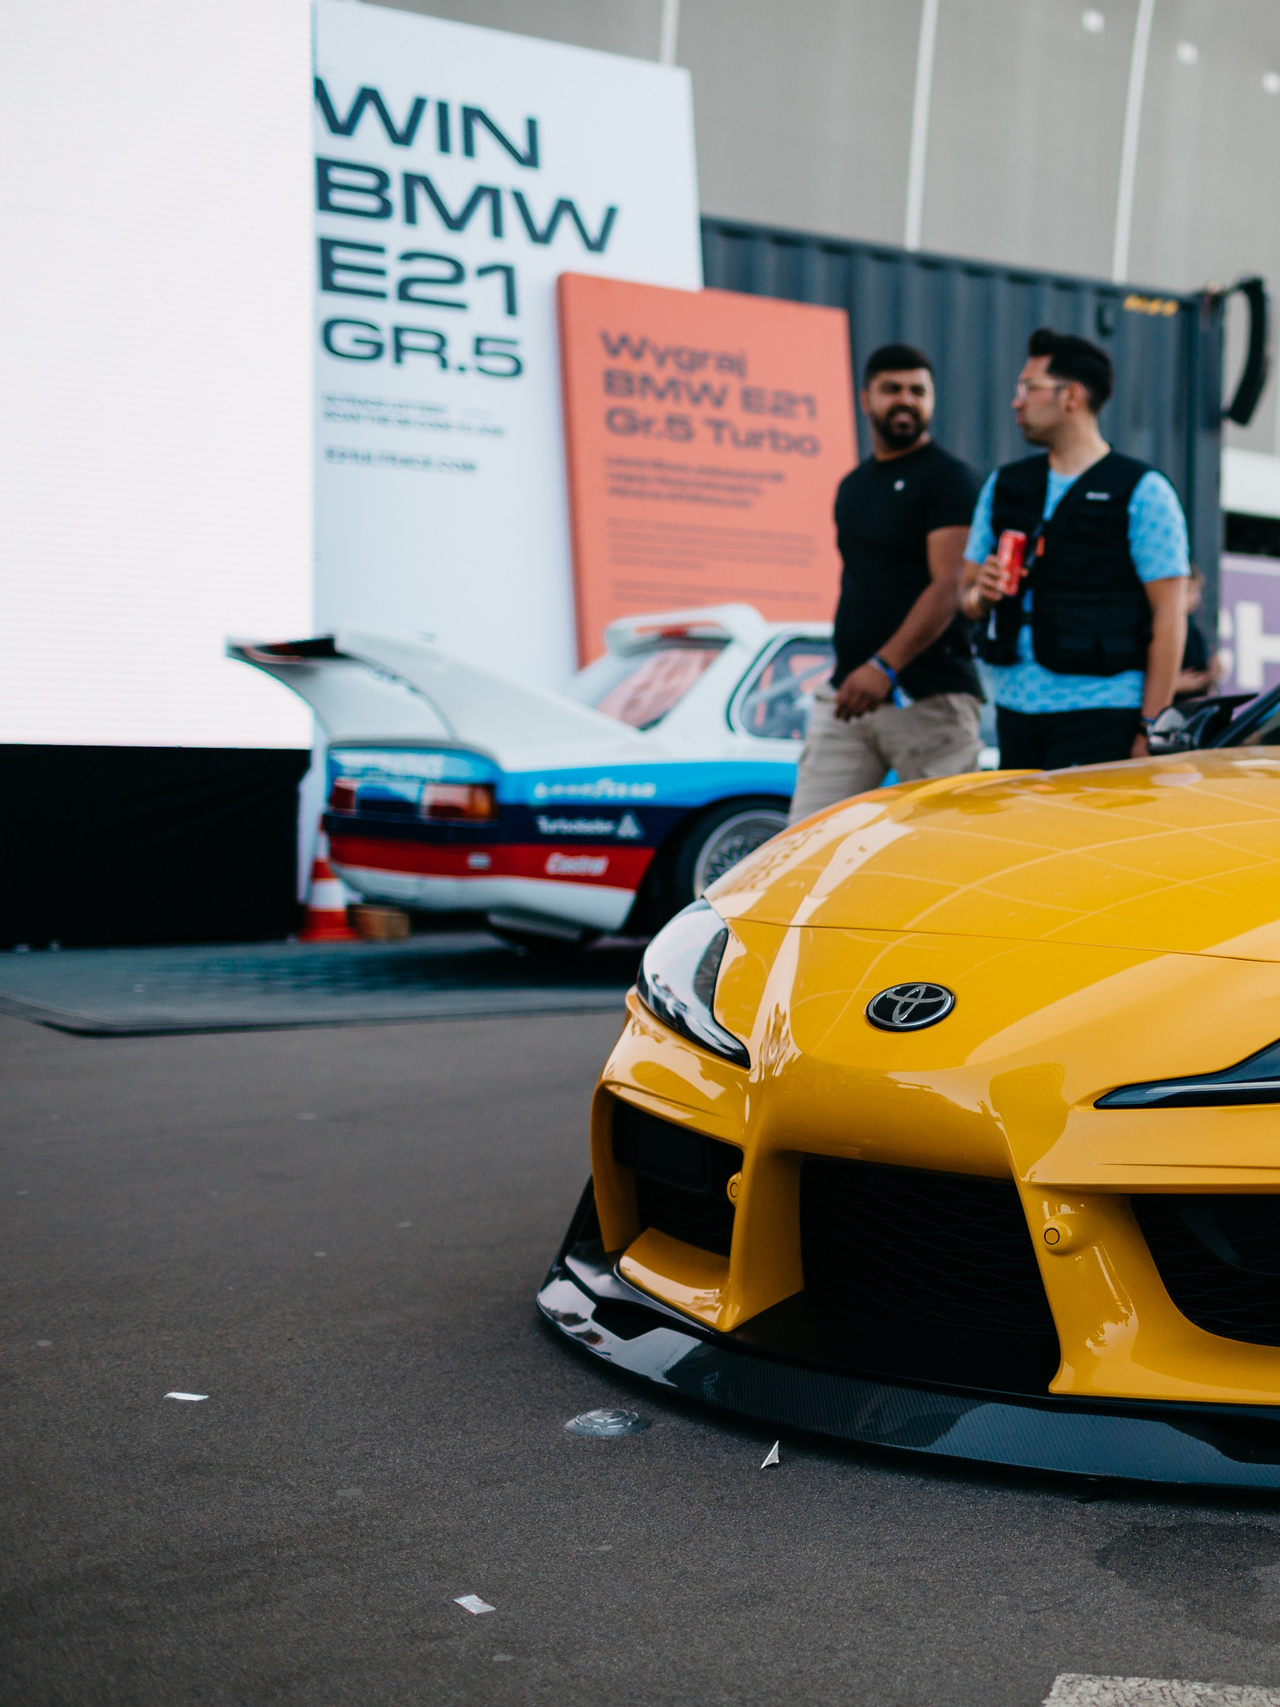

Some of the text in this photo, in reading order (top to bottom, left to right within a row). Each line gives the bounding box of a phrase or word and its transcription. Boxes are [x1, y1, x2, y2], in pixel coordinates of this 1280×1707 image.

[314, 76, 539, 168] WIN
[315, 157, 618, 252] BMW
[319, 237, 518, 316] E21
[322, 318, 524, 377] GR.5
[600, 330, 747, 379] Wygraj
[603, 367, 817, 420] BMW E21
[605, 406, 821, 457] Gr.5 Turbo
